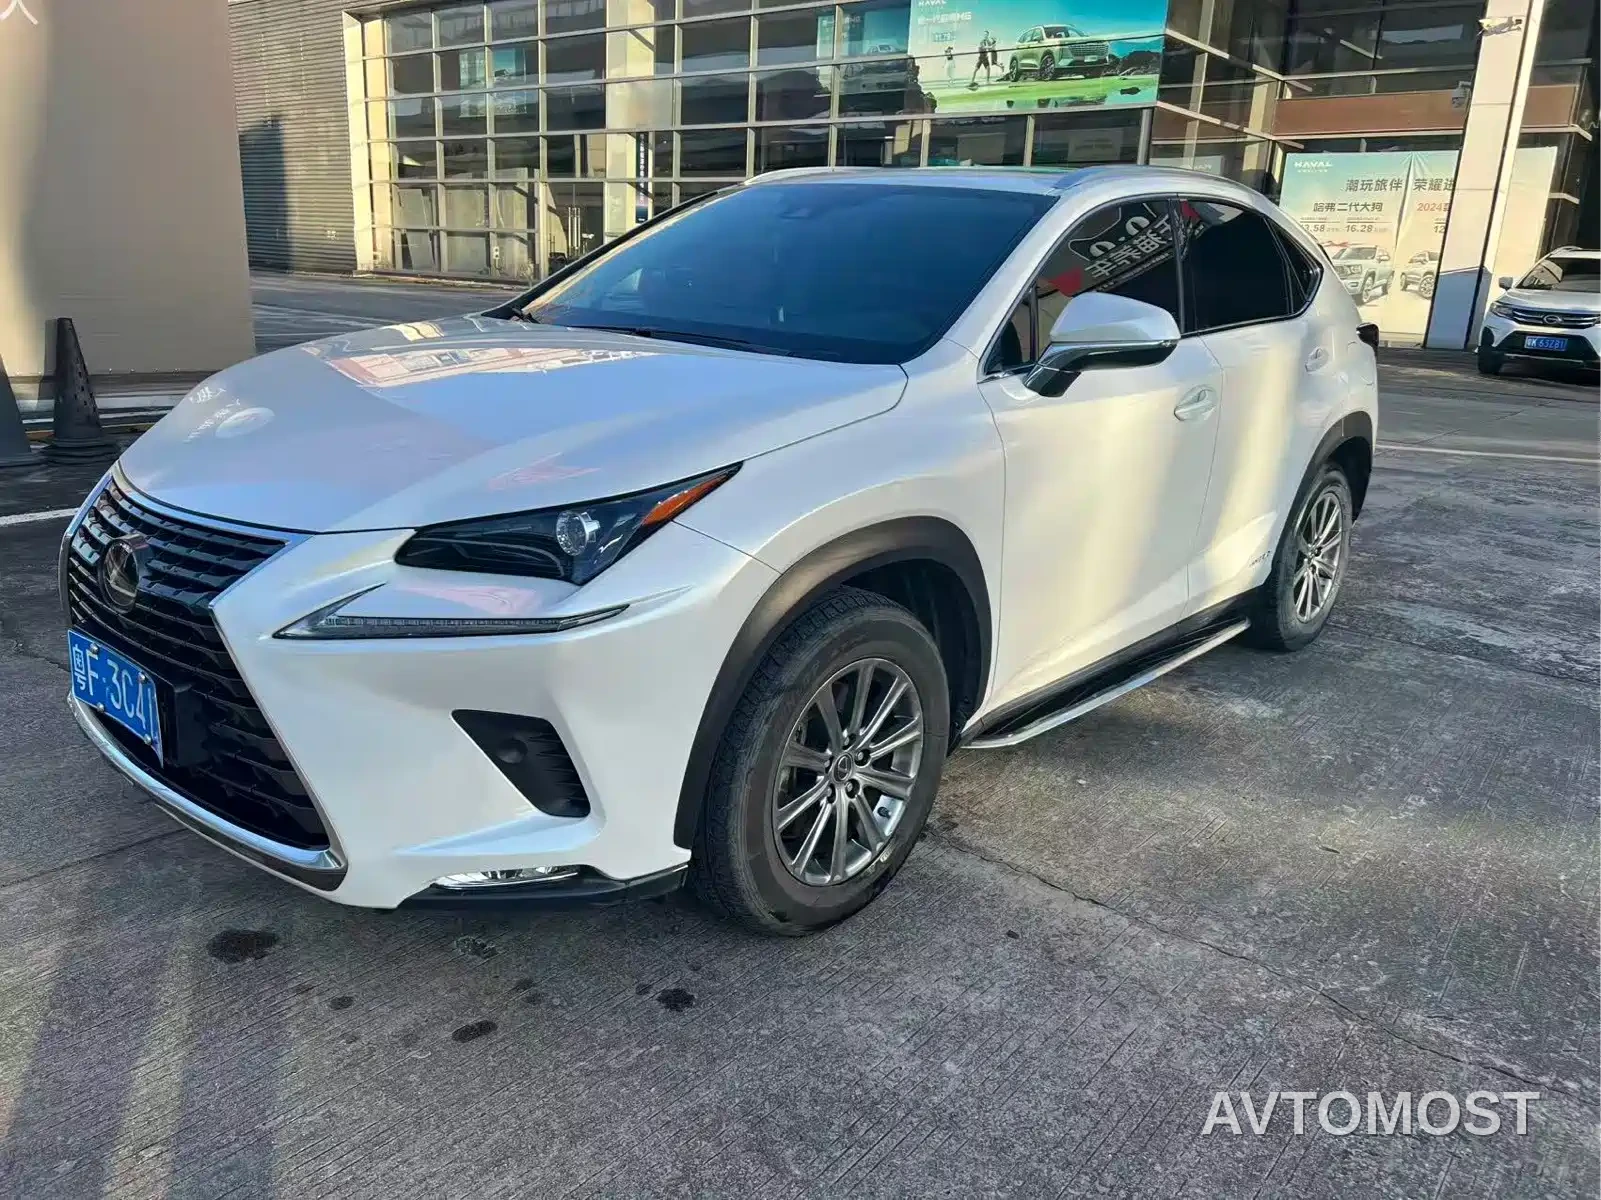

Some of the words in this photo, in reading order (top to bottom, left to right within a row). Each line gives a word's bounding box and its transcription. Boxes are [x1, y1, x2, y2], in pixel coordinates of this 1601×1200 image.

[1345, 179, 1403, 192] 潮玩旅伴
[1313, 202, 1383, 212] 哈弗二代大狗
[1346, 224, 1373, 233] 16.28
